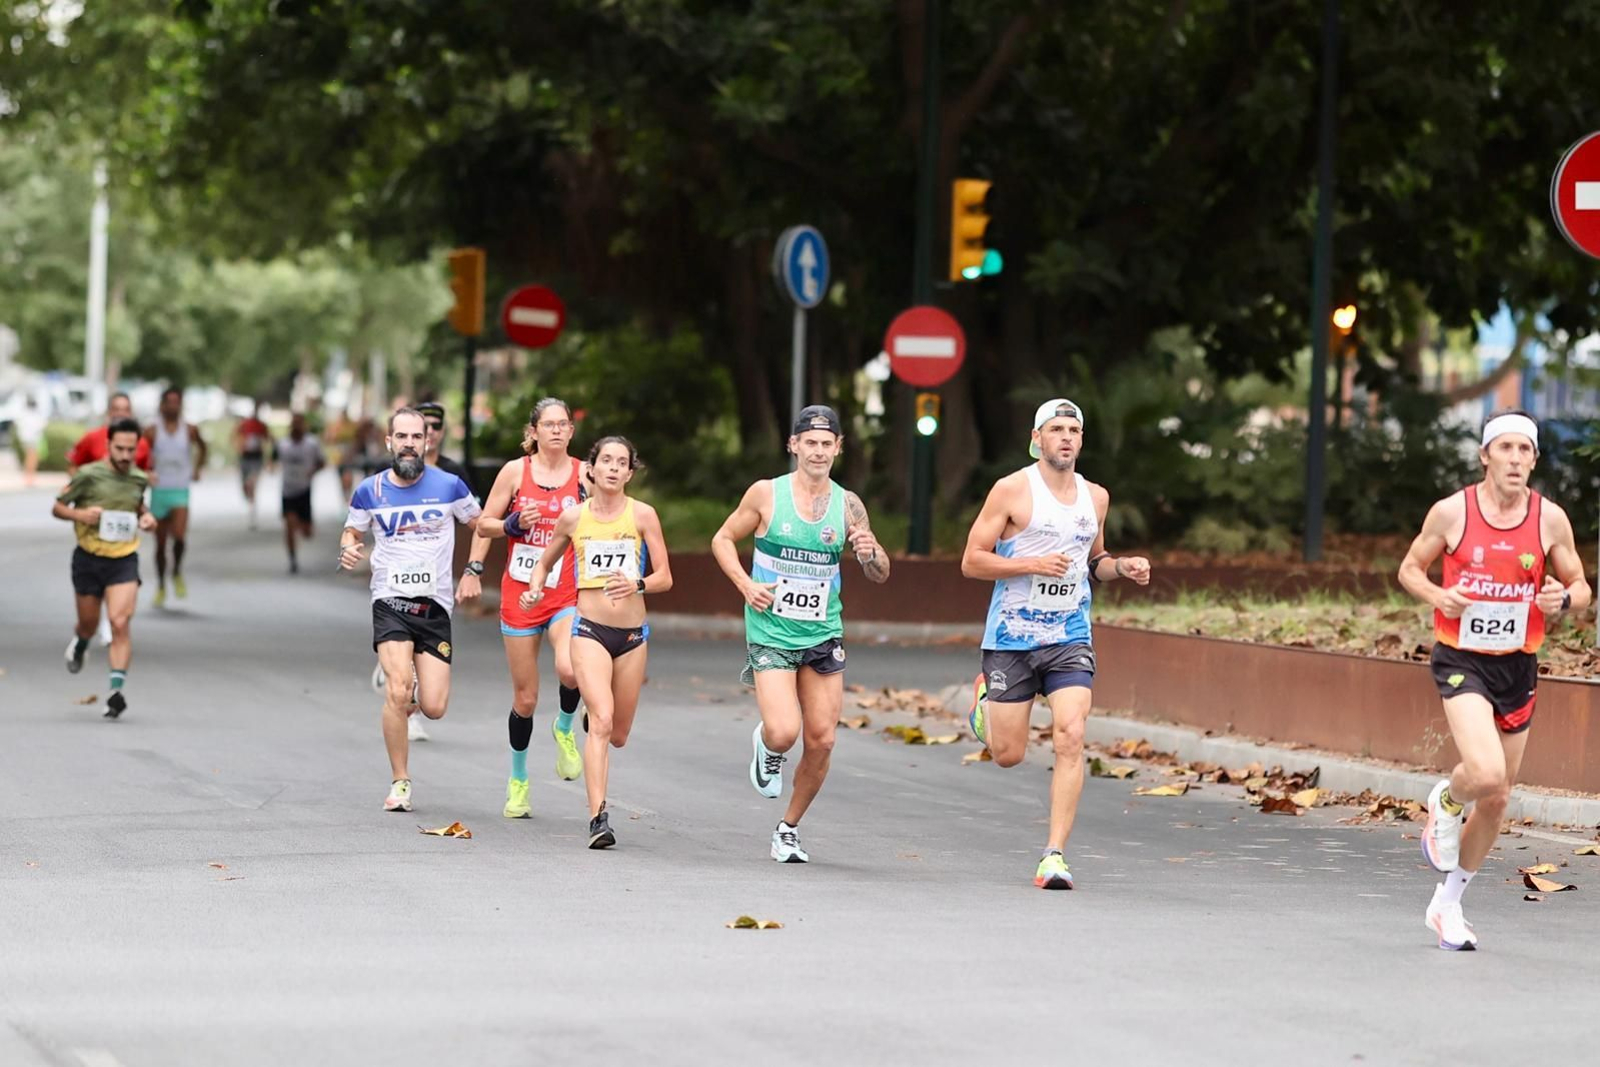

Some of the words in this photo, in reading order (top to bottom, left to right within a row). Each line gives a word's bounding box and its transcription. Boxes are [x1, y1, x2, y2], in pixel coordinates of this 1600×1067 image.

[375, 509, 443, 537] VAS
[524, 524, 553, 546] Véle
[591, 553, 626, 568] 477
[780, 547, 831, 564] ATLETISMO
[771, 560, 832, 578] TORREMOLINO
[392, 572, 431, 585] 1200
[1037, 582, 1076, 597] 1067
[782, 591, 820, 609] 403
[1470, 617, 1516, 636] 624
